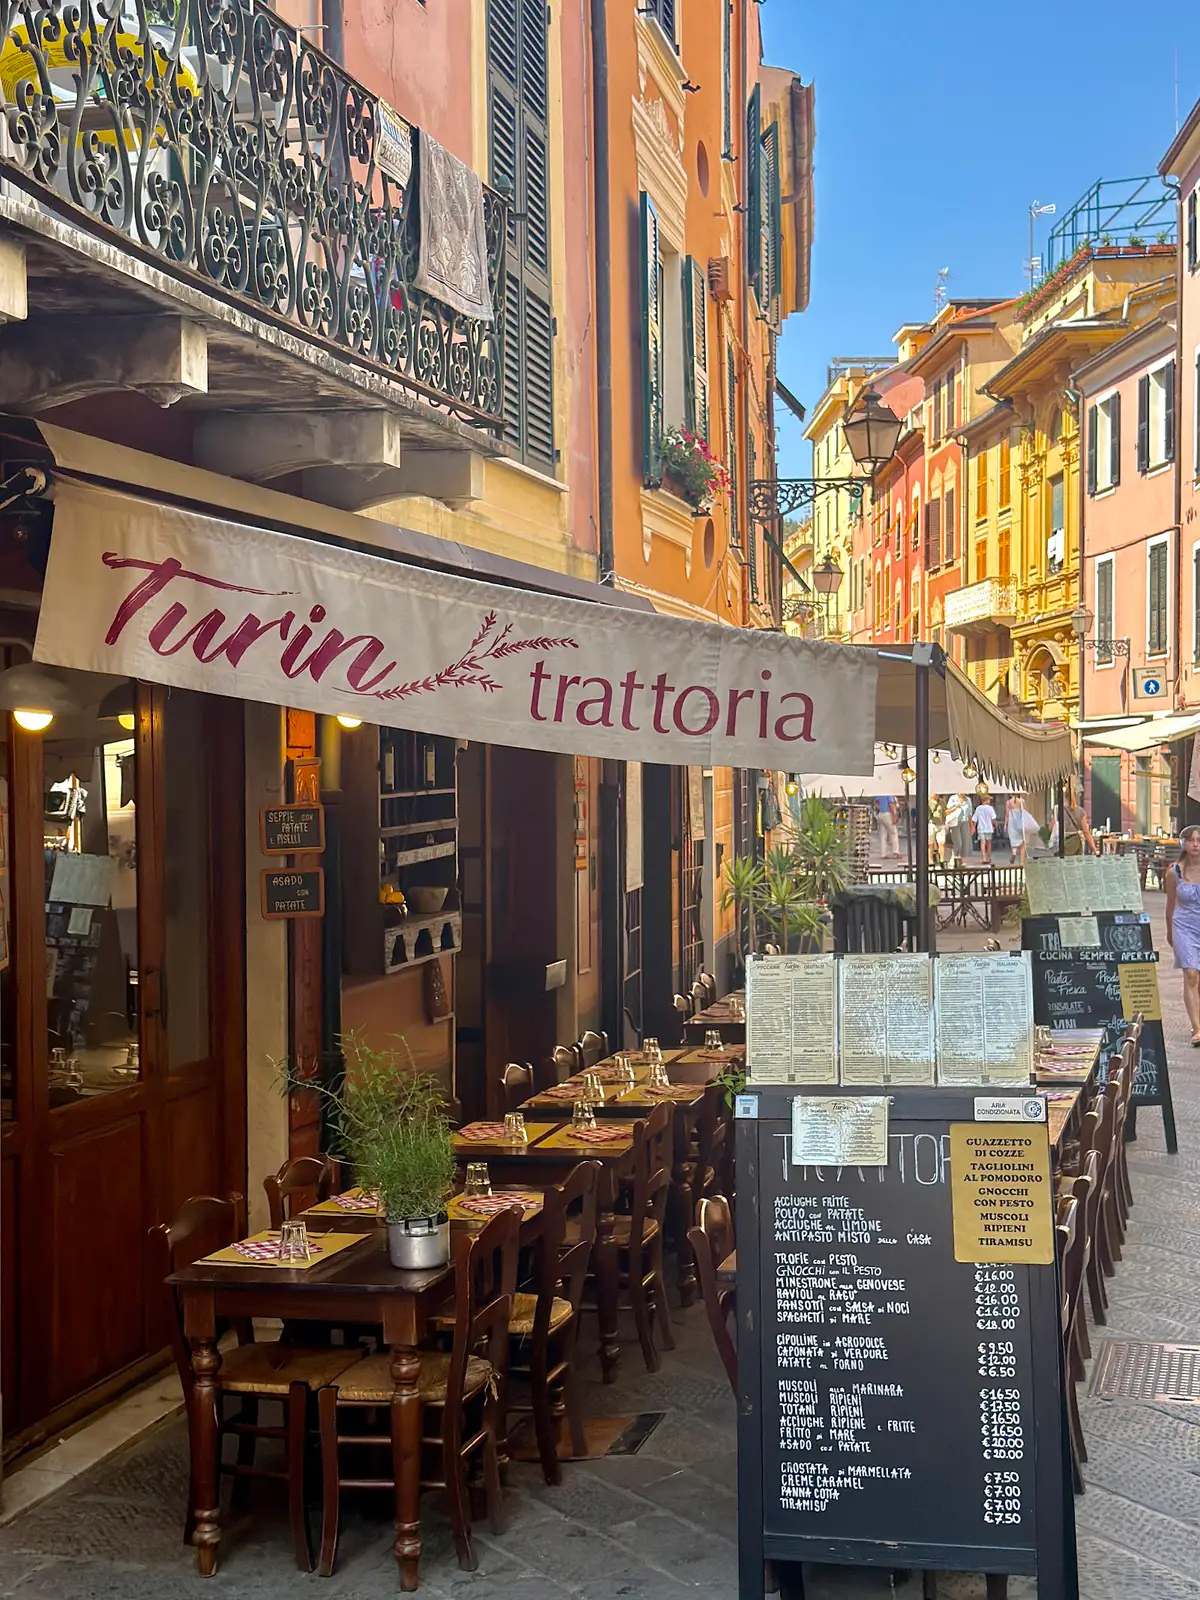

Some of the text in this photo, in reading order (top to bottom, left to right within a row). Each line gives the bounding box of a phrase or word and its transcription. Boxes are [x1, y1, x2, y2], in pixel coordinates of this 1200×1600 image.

[102, 552, 816, 742] Turin trattoria
[268, 811, 295, 823] SEPPIE
[281, 822, 309, 833] PATATE
[276, 833, 301, 845] PISELLI
[272, 875, 303, 887] ASADO
[275, 900, 306, 911] PATATE
[1039, 951, 1157, 961] CUCINA SEMPRE APERTA
[1044, 969, 1074, 986] Pasta
[1057, 985, 1087, 996] Fresca
[976, 1108, 1021, 1116] CONDIZIONATA
[966, 1138, 1032, 1147] GUAZZETTO
[975, 1149, 1025, 1158] DI COZZE
[970, 1162, 1034, 1171] TAGLIOLINI
[963, 1174, 1043, 1183] AL POMODORO
[978, 1187, 1029, 1196] GNOCCHI
[774, 1194, 850, 1208] ACCIUGHE FRITTE
[974, 1198, 1034, 1208] CON PESTO
[775, 1207, 805, 1222] POLPO
[828, 1208, 864, 1221] PATATE
[980, 1212, 1030, 1222] MUSCOLI
[774, 1219, 823, 1231] ACCIUGHE
[842, 1220, 882, 1232] LIMONE
[983, 1224, 1027, 1233] RIPIENI
[774, 1229, 833, 1243] ANTIPASTO
[838, 1229, 871, 1244] MISTO
[906, 1233, 932, 1245] CASA
[978, 1237, 1033, 1247] TIRAMISU
[774, 1252, 809, 1265] TROFIE
[829, 1254, 857, 1266] PESTO
[776, 1265, 826, 1276] GNOCCHI
[842, 1267, 851, 1275] IL
[853, 1266, 882, 1276] PESTO
[974, 1270, 1015, 1282] €16.00
[776, 1277, 838, 1289] MINESTRONE
[857, 1279, 906, 1291] GENOVESE
[974, 1282, 1016, 1294] €12.00
[776, 1288, 814, 1300] RAVIOLI
[975, 1293, 1019, 1306] €16.00
[776, 1299, 825, 1311] PANSOTTI
[845, 1301, 876, 1313] SALSA
[887, 1301, 911, 1314] NOCI
[976, 1306, 1021, 1318] €16.00
[776, 1311, 825, 1323] SPAGHETTI
[842, 1312, 871, 1324] MARE
[976, 1318, 1016, 1330] €18.00
[776, 1333, 819, 1347] CIPOLLINE
[835, 1336, 886, 1349] AGRODOLCE
[777, 1346, 824, 1358] CAPONATA
[844, 1348, 889, 1360] VERDURE
[778, 1356, 812, 1369] PATATE
[834, 1358, 865, 1371] FORNO
[778, 1379, 818, 1392] MUSCOLI
[852, 1383, 904, 1397] MARINARA
[779, 1391, 863, 1406] MUSCOLI RIPIENI
[780, 1403, 865, 1418] TOTANI RIPIENI
[780, 1415, 825, 1428] ACCIUGHE
[831, 1417, 867, 1430] RIPIENE
[887, 1420, 916, 1433] FRITTE
[780, 1428, 812, 1439] FRITTO
[829, 1429, 857, 1441] MARE
[780, 1439, 812, 1451] ASADO
[838, 1440, 872, 1453] PATATE
[781, 1462, 829, 1475] CROSTATA
[847, 1465, 912, 1479] MARMELLATA
[781, 1474, 864, 1490] CREME CARAMEL
[781, 1486, 840, 1501] PANNA COTTA
[983, 1510, 1022, 1525] €7.50
